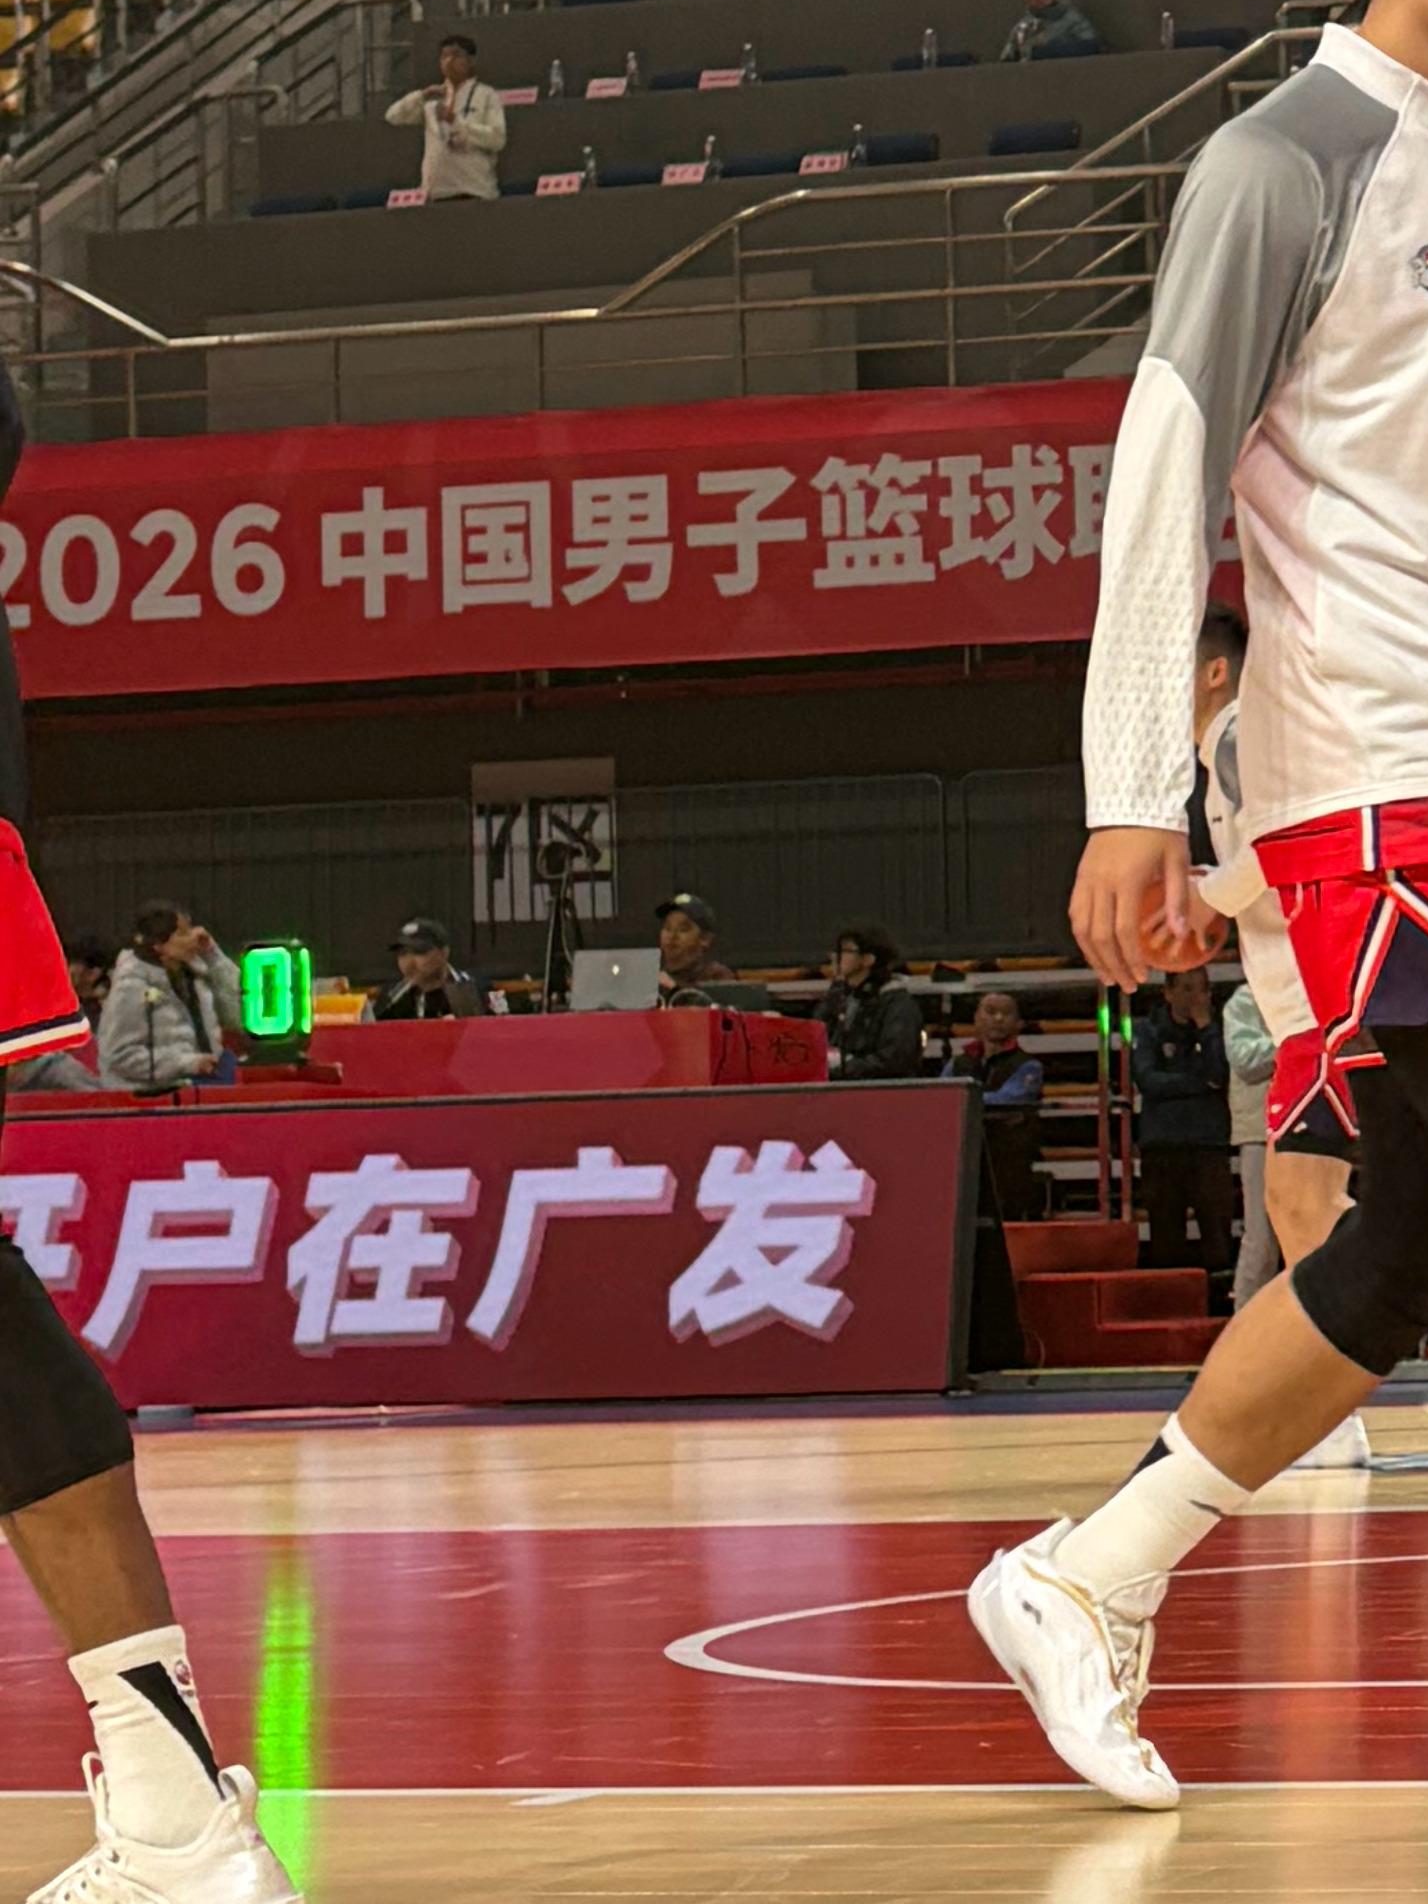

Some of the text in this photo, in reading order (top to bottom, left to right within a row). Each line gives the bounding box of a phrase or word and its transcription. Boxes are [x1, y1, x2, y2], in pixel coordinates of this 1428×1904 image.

[321, 442, 1237, 623] 中国男子篮球
